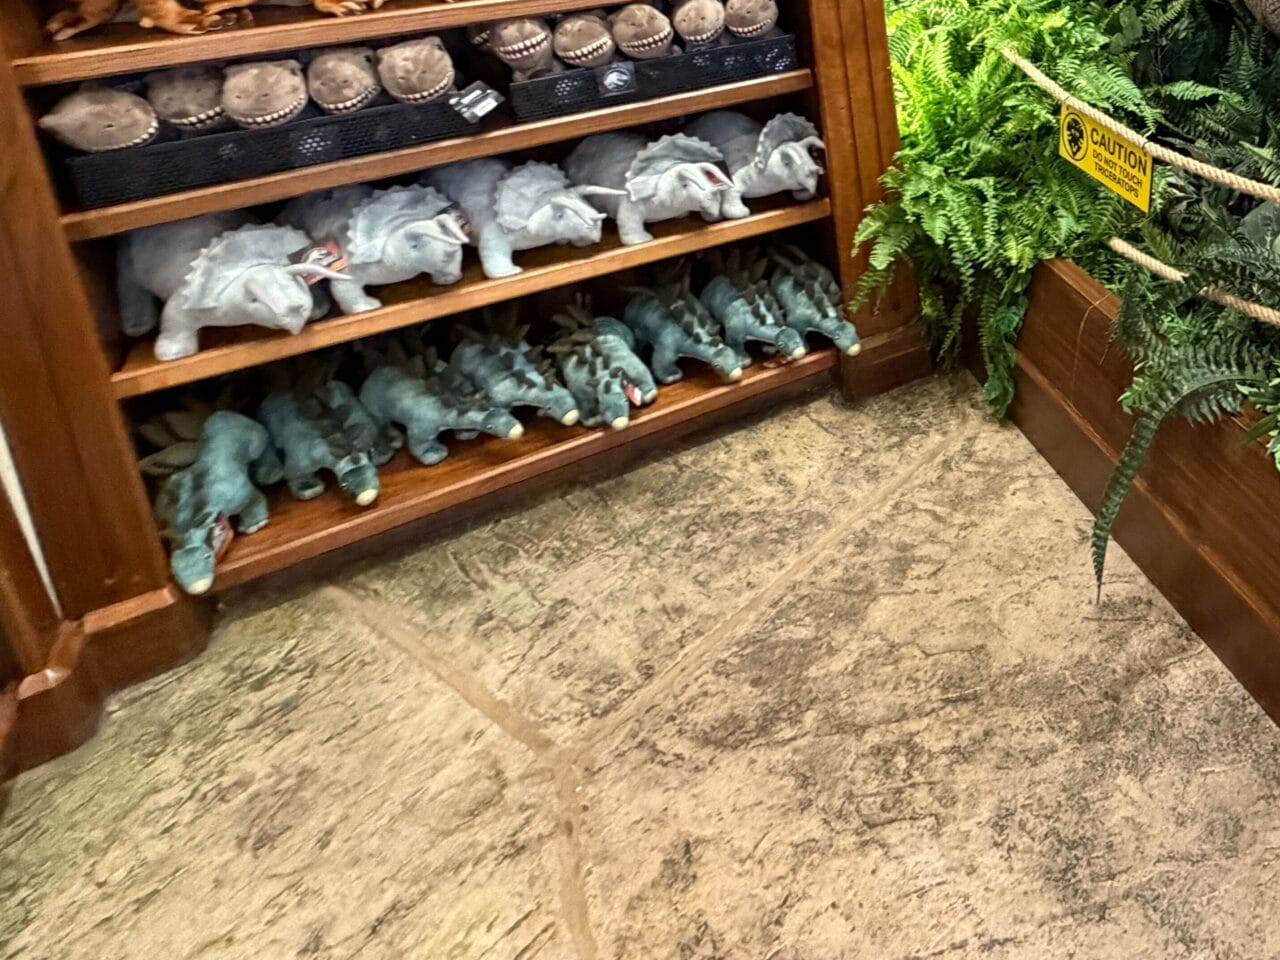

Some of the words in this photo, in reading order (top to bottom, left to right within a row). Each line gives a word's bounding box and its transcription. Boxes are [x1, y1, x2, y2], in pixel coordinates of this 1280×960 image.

[1090, 128, 1147, 177] CAUTION
[1093, 149, 1103, 161] DO
[1104, 155, 1117, 170] NOT
[1119, 163, 1142, 188] TOUCH
[1094, 162, 1139, 198] TRICERATOPS
